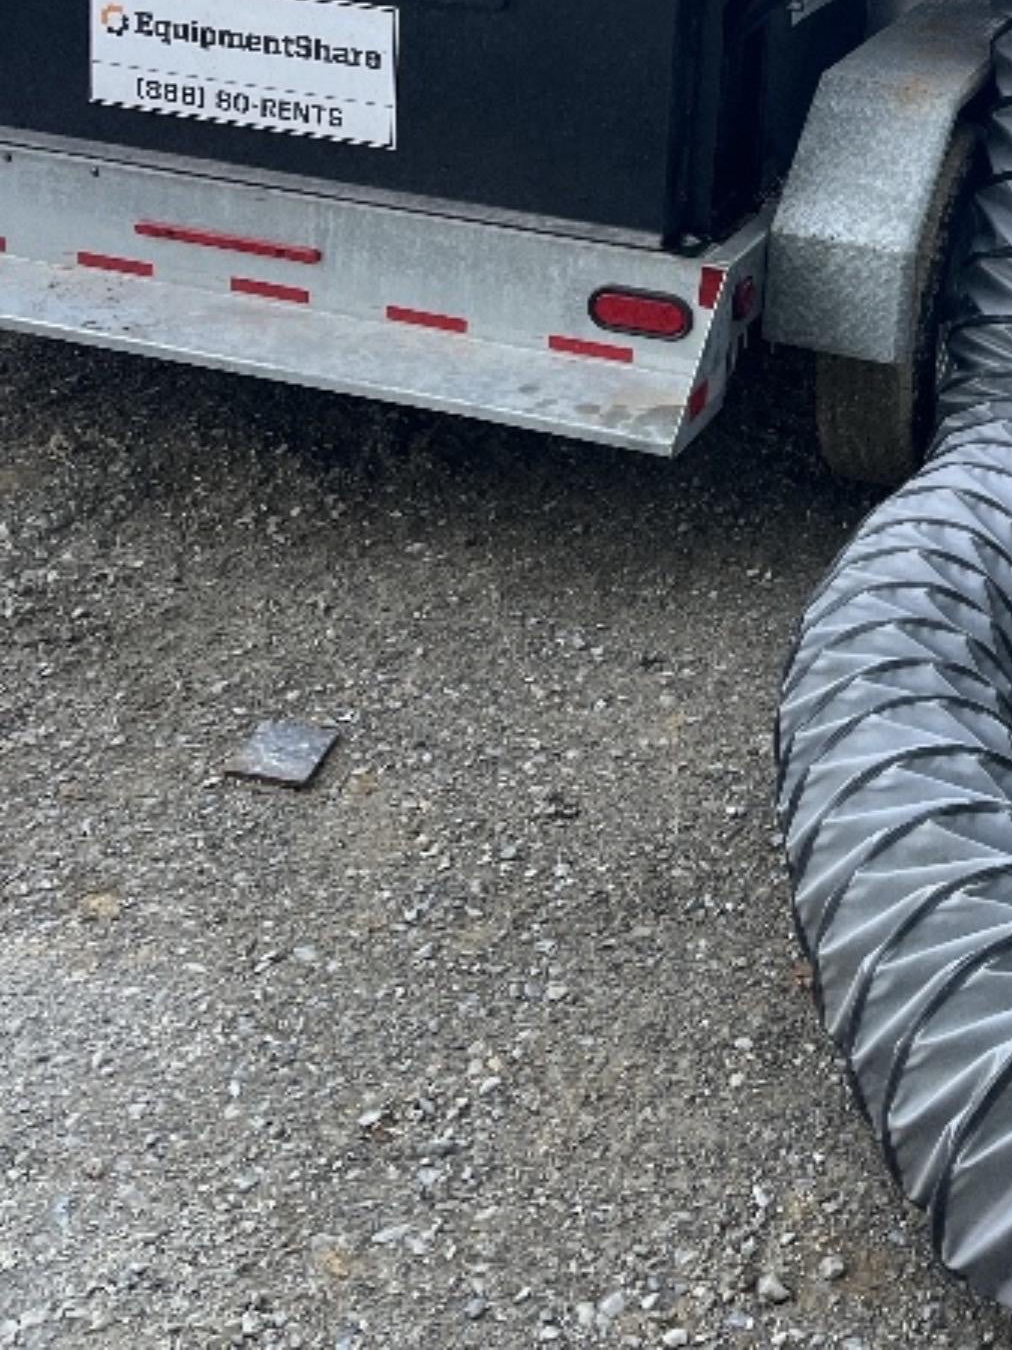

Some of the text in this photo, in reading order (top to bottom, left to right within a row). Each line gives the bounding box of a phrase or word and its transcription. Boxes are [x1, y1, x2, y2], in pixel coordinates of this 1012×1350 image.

[133, 11, 382, 70] EquipmentShare
[135, 77, 344, 128] (888) 80-RENTS
